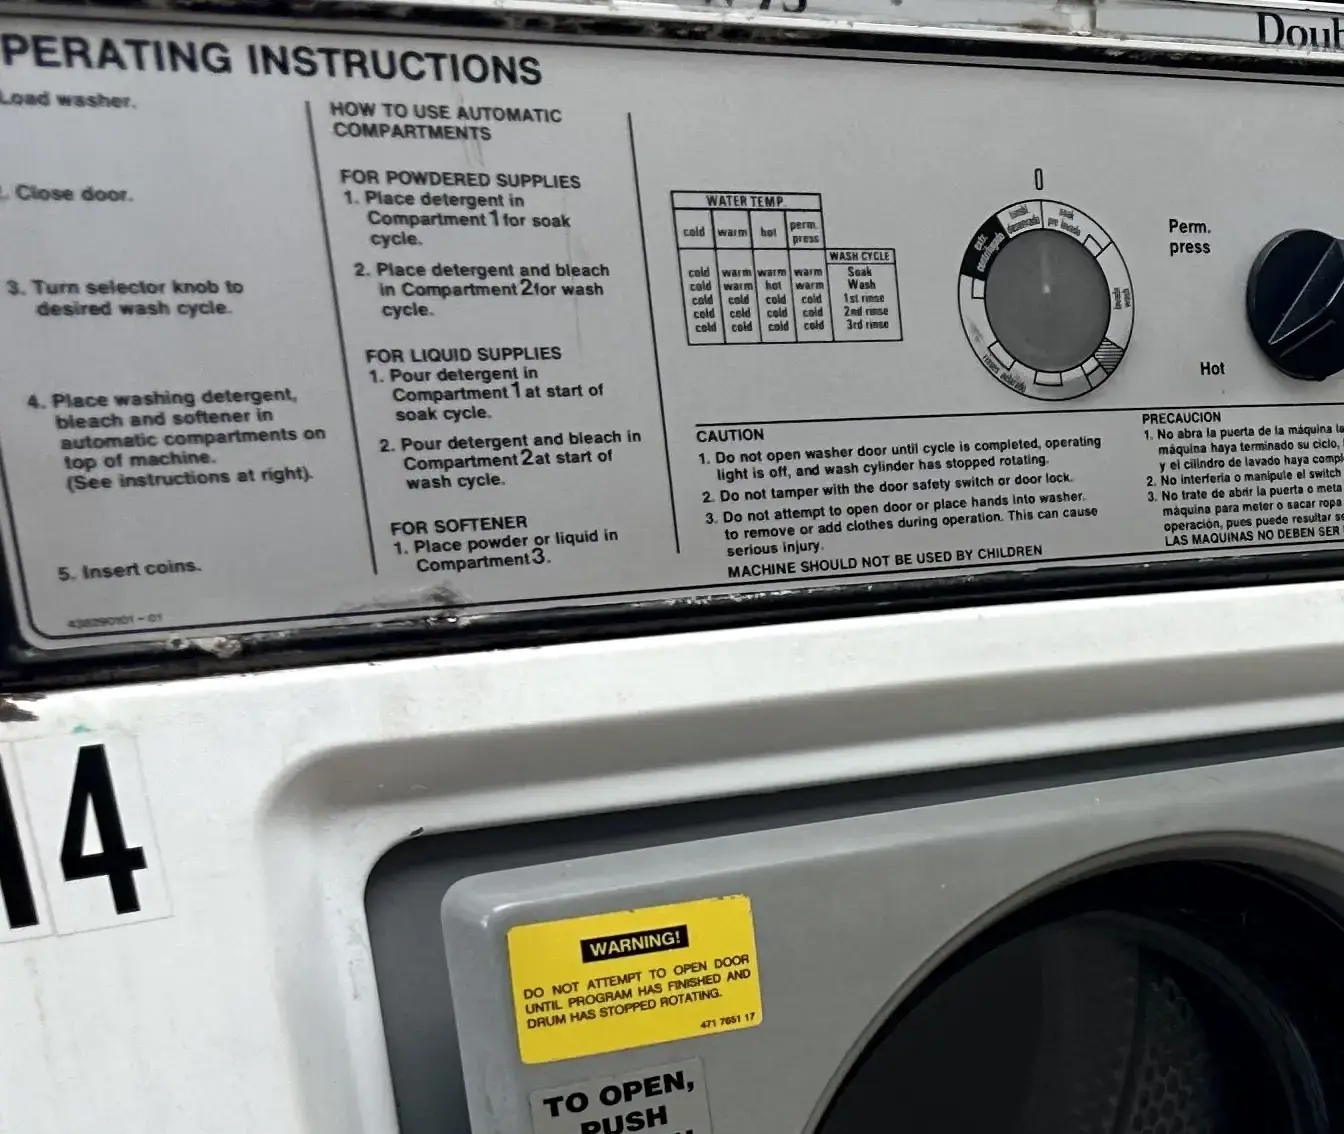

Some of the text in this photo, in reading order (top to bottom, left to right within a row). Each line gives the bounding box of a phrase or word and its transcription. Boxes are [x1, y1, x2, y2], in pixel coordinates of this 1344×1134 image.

[0, 32, 543, 86] PERATING INSTRUCTIONS
[330, 102, 562, 123] HOW TO USE AUTOMATIC
[333, 122, 492, 140] COMPARTMENTS
[340, 170, 582, 188] FOR POWDERED SUPPLIES
[706, 195, 748, 207] WATER
[1169, 219, 1211, 234] Perm.
[830, 252, 889, 261] WASH CYCLE
[1170, 239, 1211, 256] press
[366, 347, 562, 363] FOR LIQUID SUPPLIES
[1200, 361, 1225, 375] Hot
[697, 429, 764, 442] CAUTION
[716, 452, 735, 464] Do
[741, 451, 762, 462] not
[767, 450, 800, 463] open
[806, 447, 853, 459] washer
[858, 445, 887, 456] door
[894, 443, 918, 454] until
[923, 442, 955, 455] cycle
[960, 441, 970, 451] is
[1045, 437, 1101, 448] operating
[718, 468, 748, 482] light
[753, 467, 764, 478] is
[770, 465, 791, 478] off,
[797, 464, 819, 476] and
[825, 462, 858, 474] wash
[863, 460, 914, 475] cylinder
[919, 460, 941, 470] has
[946, 456, 995, 470] stopped
[390, 515, 528, 535] FOR SOFTENER
[81, 561, 141, 580] Insert
[728, 545, 1043, 577] MACHINE SHOULD NOT BE USED BY CHILDREN
[589, 930, 681, 957] WARNING!
[524, 954, 749, 1000] DO NOT ATTEMPT TO OPEN DOOR
[525, 969, 751, 1014] UNTIL PROGRAM HAS FINISHED AND
[527, 1014, 567, 1029] DRUM
[570, 1009, 596, 1023] HAS
[600, 1001, 656, 1018] STOPPED
[543, 1070, 694, 1117] TO OPEN,
